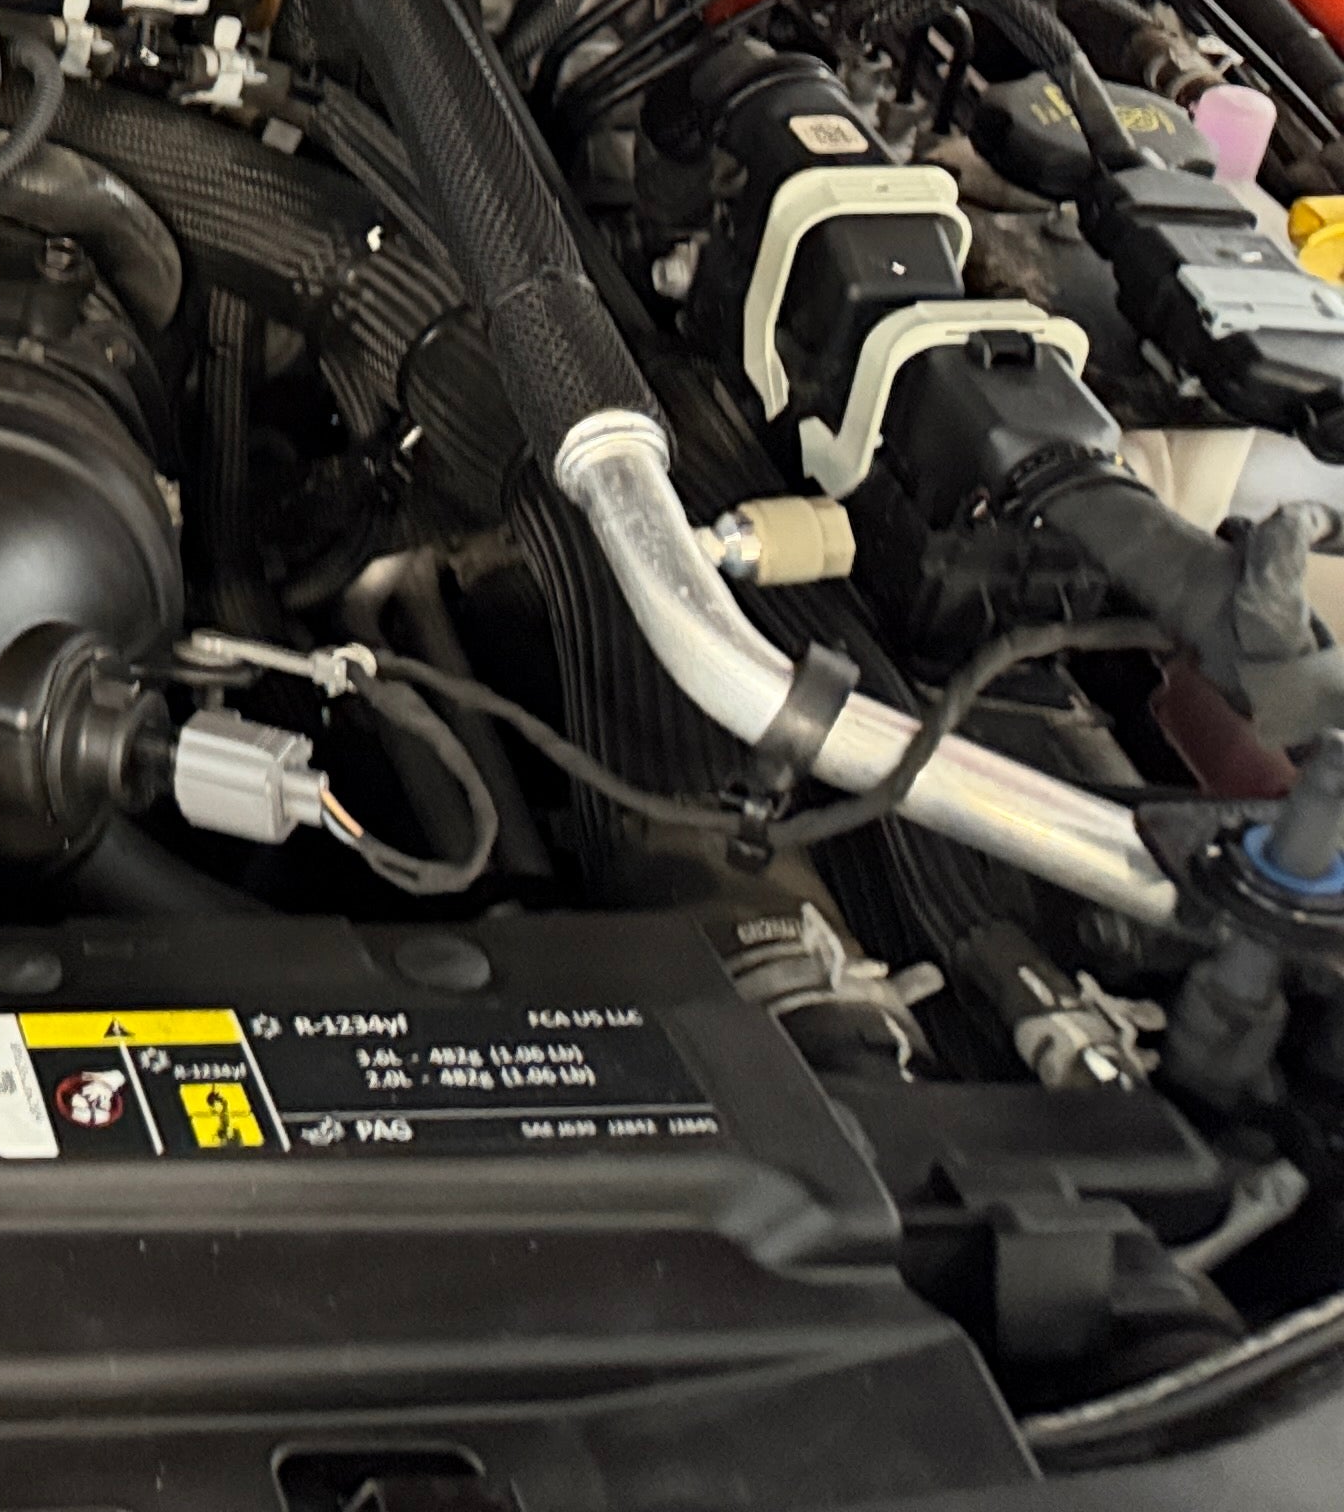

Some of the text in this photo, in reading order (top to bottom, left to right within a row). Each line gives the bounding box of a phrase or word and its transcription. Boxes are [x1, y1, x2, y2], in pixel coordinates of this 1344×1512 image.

[293, 1012, 408, 1038] R-1234yf
[527, 1007, 644, 1029] FCA US LLC
[173, 1061, 249, 1082] R-1234yf
[355, 1118, 413, 1142] PAG
